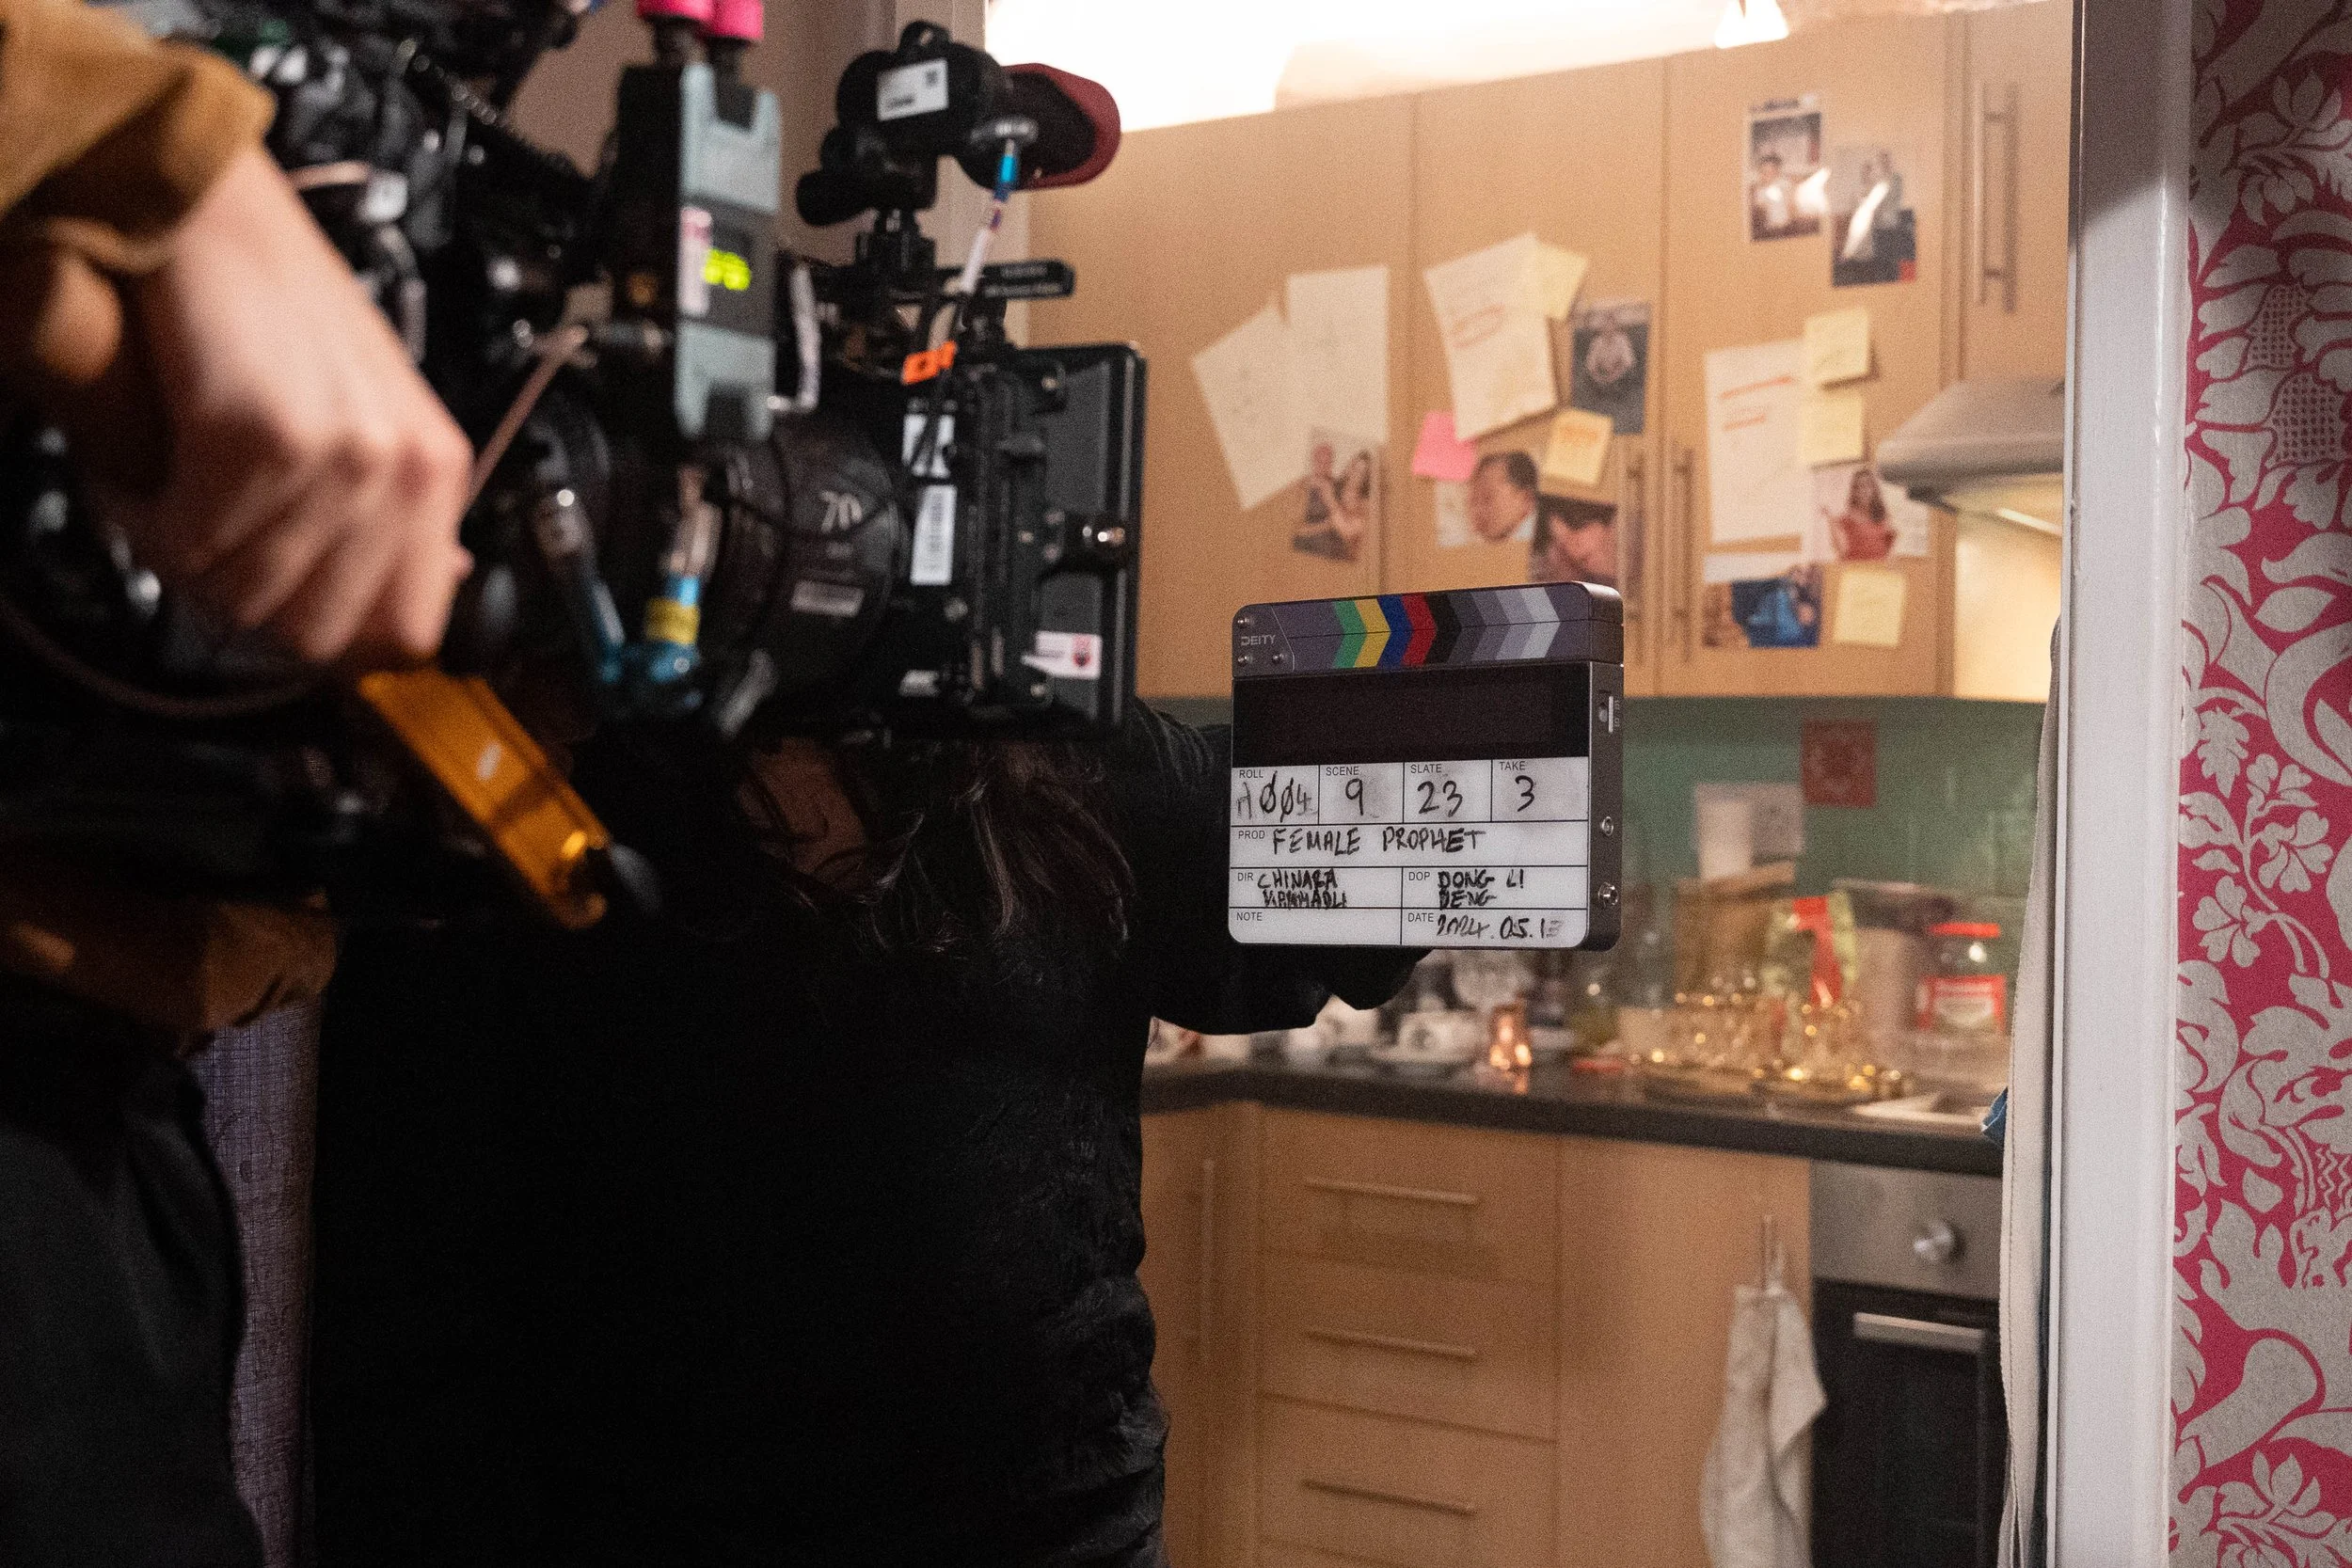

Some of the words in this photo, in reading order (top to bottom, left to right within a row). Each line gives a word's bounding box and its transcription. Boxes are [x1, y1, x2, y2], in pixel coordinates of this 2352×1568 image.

[1241, 634, 1276, 646] DEITY
[1410, 763, 1442, 774] SLATE
[1499, 760, 1526, 771] TAKE
[1239, 769, 1263, 779] ROLL
[1326, 766, 1359, 777] SCENE
[1345, 778, 1364, 816] 9
[1417, 780, 1464, 817] 23
[1515, 775, 1535, 812] 3
[1238, 830, 1265, 840] PROD
[1273, 828, 1361, 856] FEMALE
[1382, 826, 1486, 853] PROPHET
[1237, 872, 1254, 881] DIR
[1408, 871, 1431, 881] DOP
[1438, 869, 1496, 889] DONG
[1438, 888, 1497, 911] DENG
[1236, 911, 1263, 922] NOTE
[1407, 912, 1434, 923] DATE
